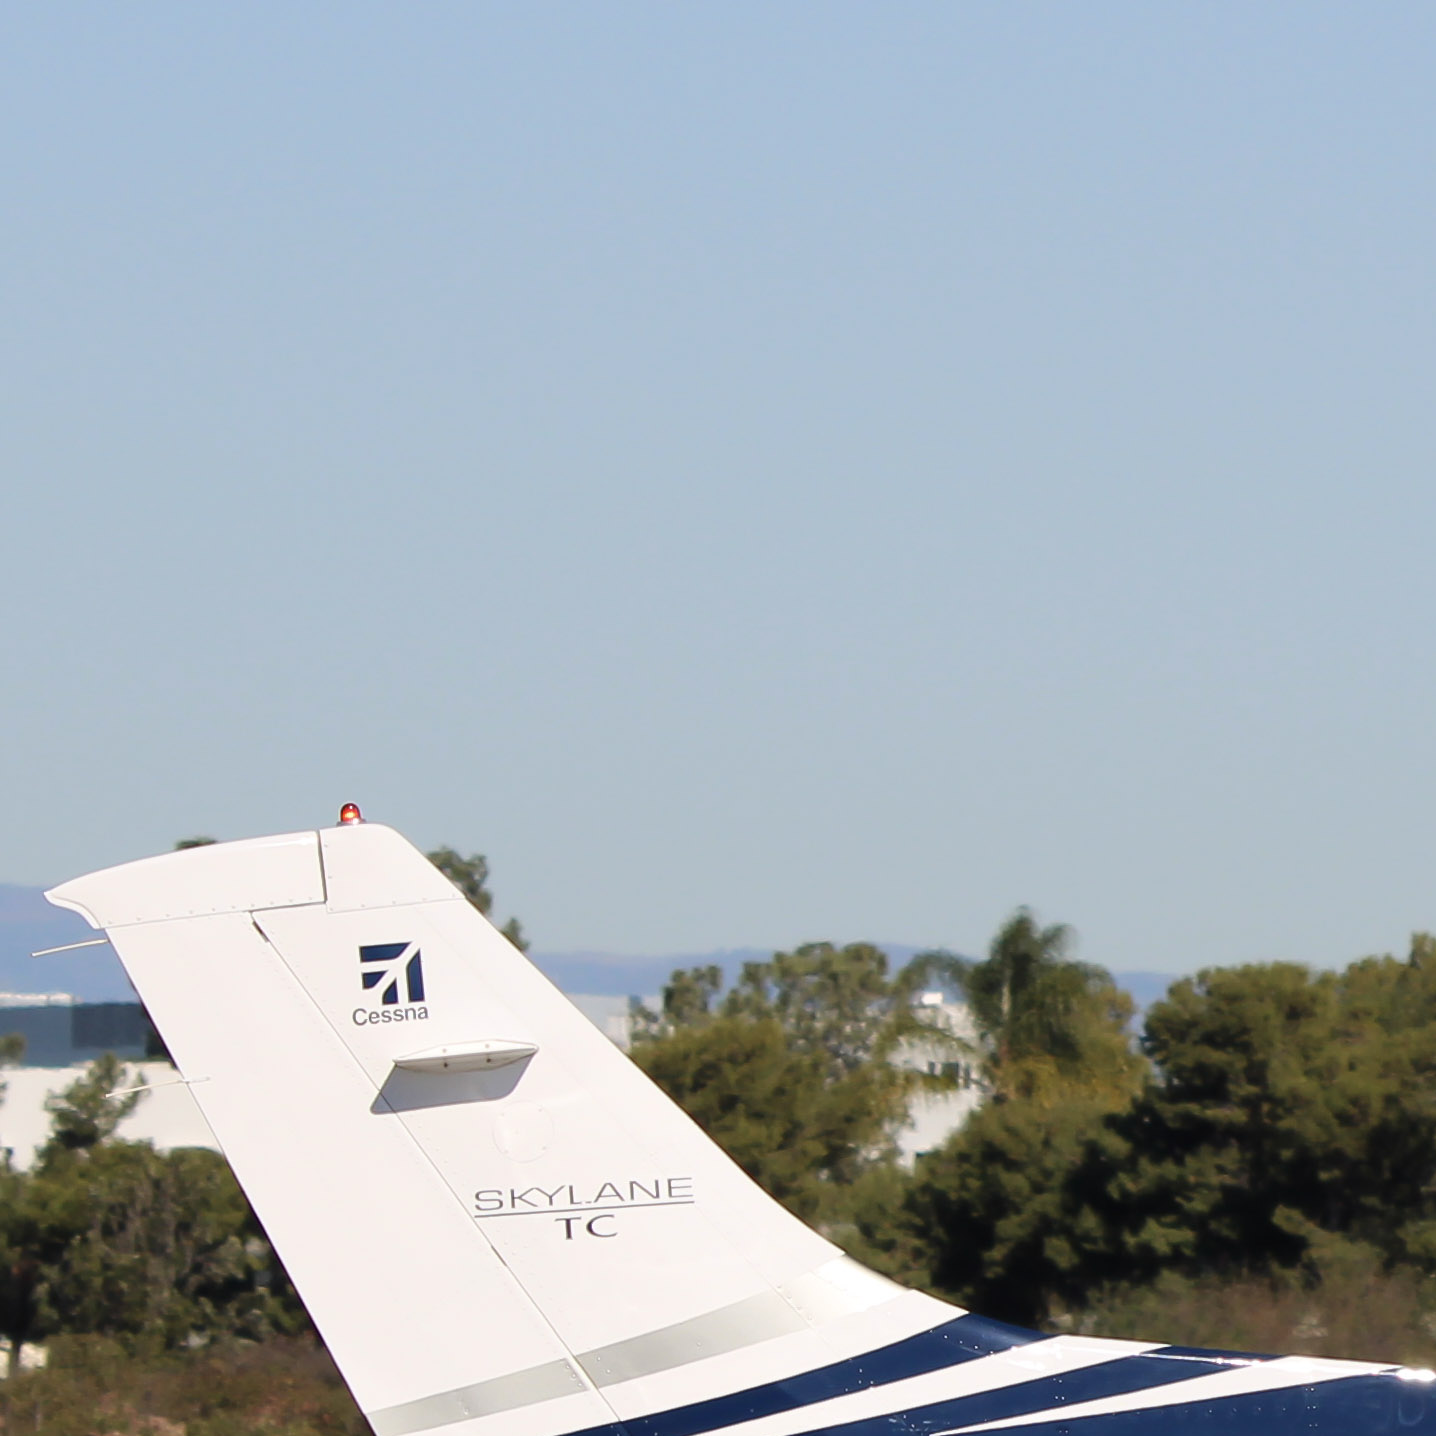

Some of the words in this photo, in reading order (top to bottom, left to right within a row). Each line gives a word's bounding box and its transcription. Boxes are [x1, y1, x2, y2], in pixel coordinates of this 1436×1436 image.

[352, 1006, 429, 1027] Cessna
[474, 1176, 694, 1212] SKYLANE
[555, 1214, 618, 1240] TC
